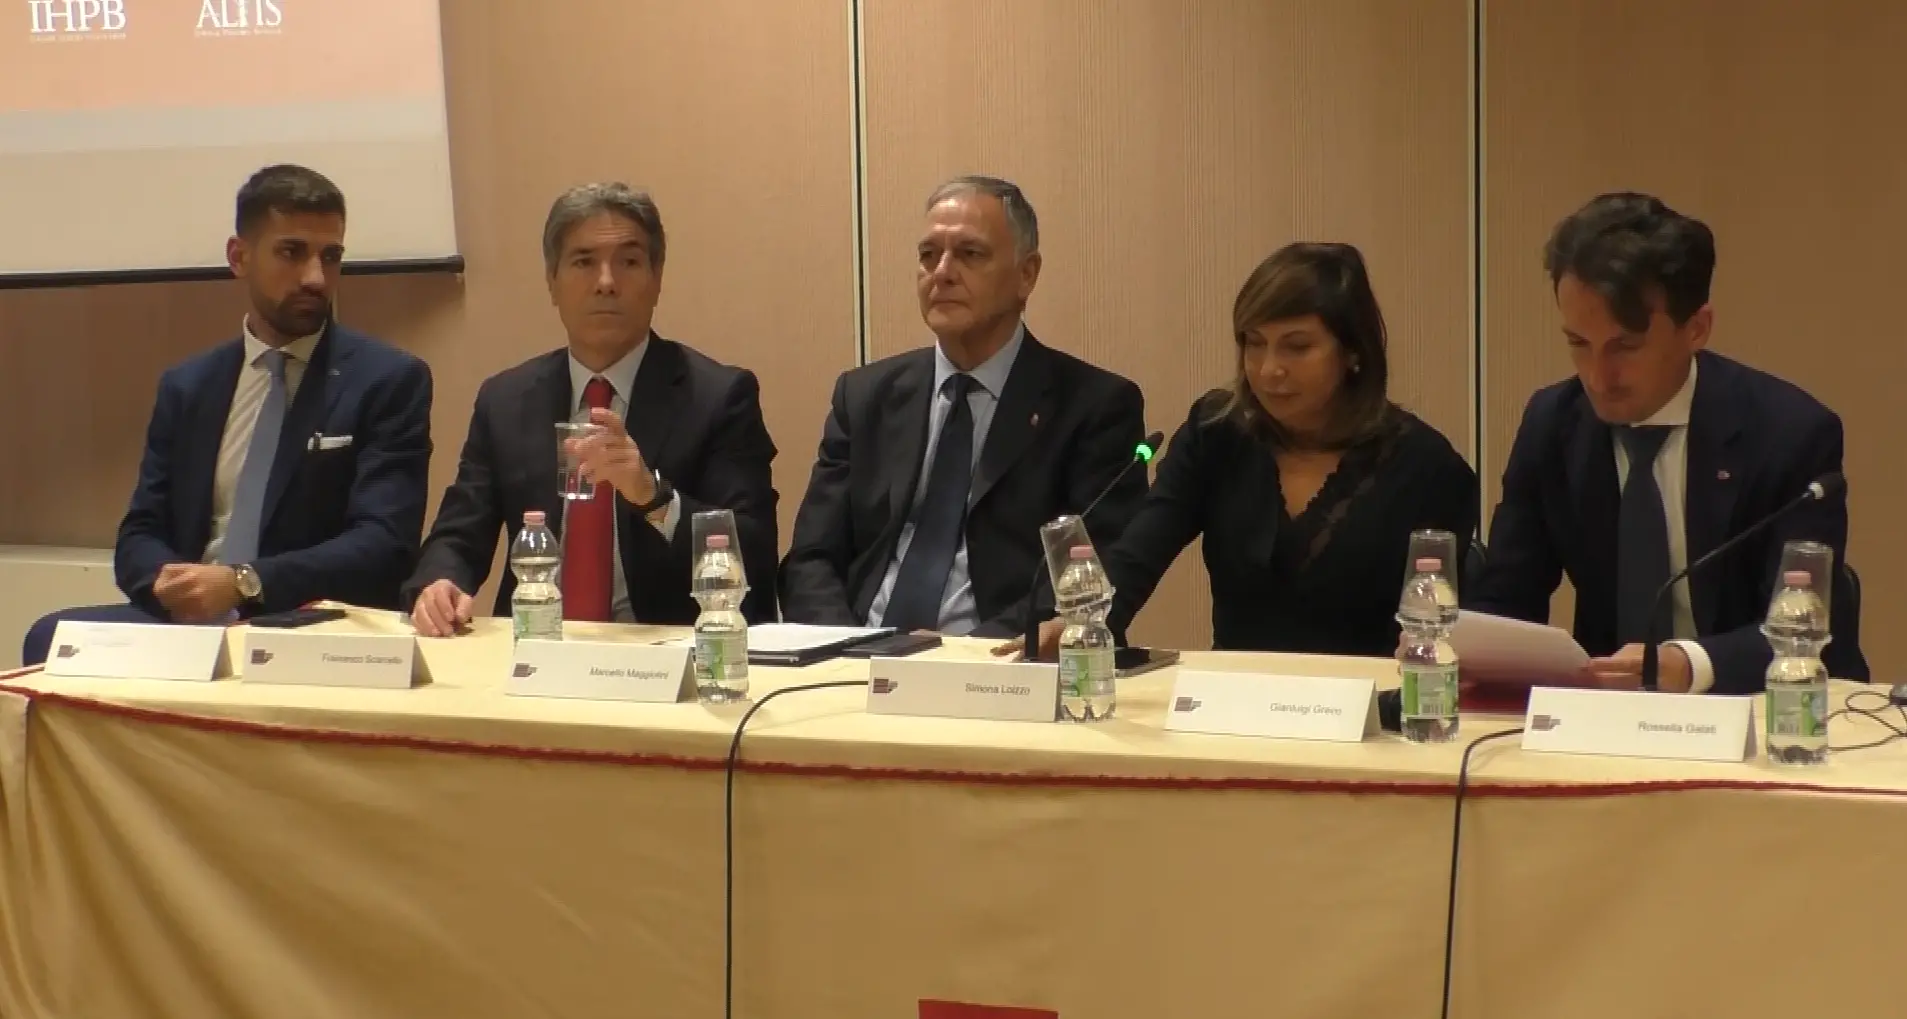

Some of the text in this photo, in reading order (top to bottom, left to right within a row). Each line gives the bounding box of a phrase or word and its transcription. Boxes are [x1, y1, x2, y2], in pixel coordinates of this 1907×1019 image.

[28, 0, 126, 32] IHPB
[965, 682, 1031, 696] Simona Loizzo
